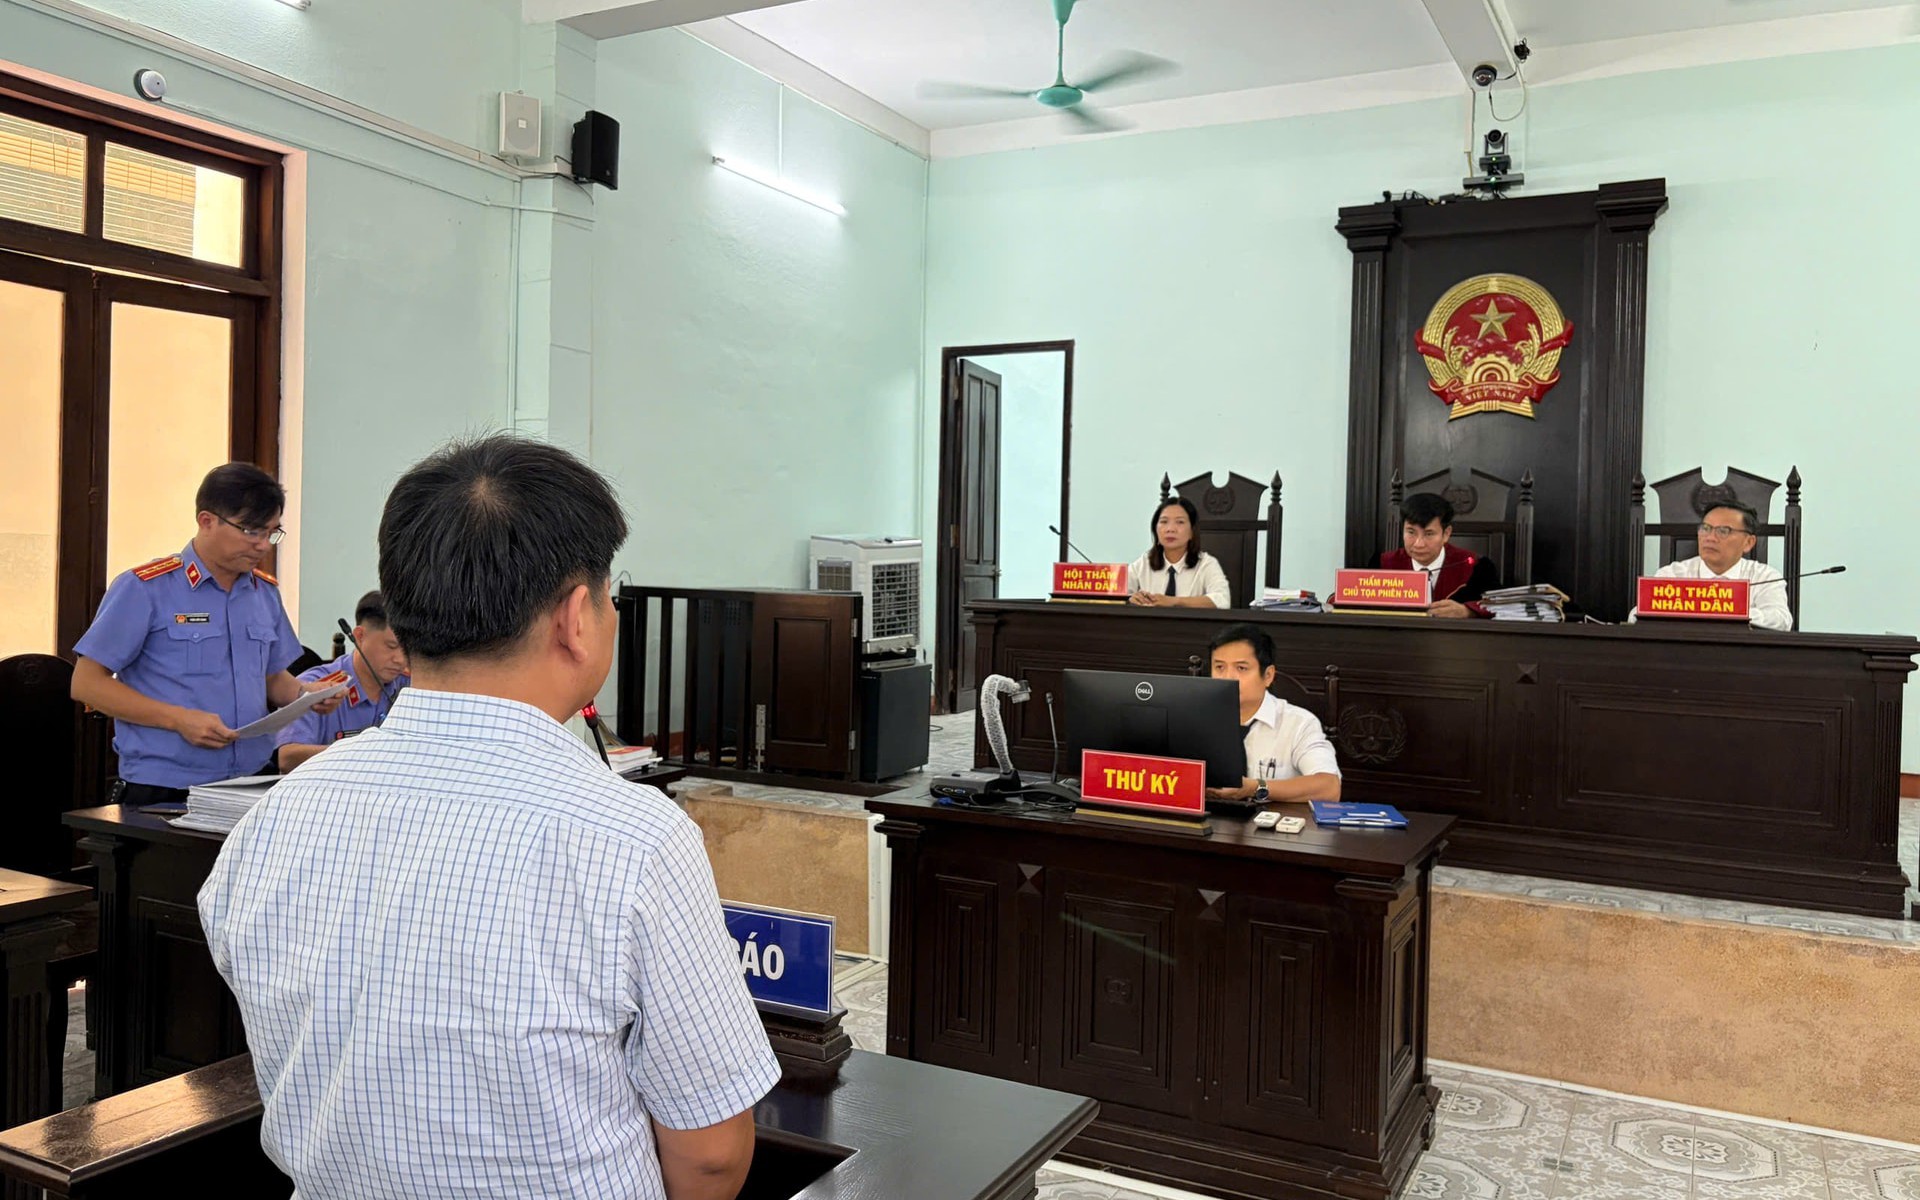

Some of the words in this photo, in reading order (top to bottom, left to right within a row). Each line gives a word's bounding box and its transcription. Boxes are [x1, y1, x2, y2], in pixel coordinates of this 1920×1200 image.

[1063, 568, 1082, 580] HỘI
[1062, 579, 1092, 590] NHÂN
[1095, 581, 1118, 591] DÂN
[1382, 578, 1404, 587] PHÁN
[1342, 585, 1359, 597] CHỦ
[1361, 588, 1376, 598] TỌA
[1378, 588, 1401, 598] PHIÊN
[1653, 584, 1681, 599] HỘI
[1685, 583, 1732, 599] THẨM
[1651, 598, 1695, 610] NHÂN
[1700, 599, 1734, 612] DÂN
[1103, 768, 1146, 792] THƯ
[1150, 770, 1179, 795] KÝ
